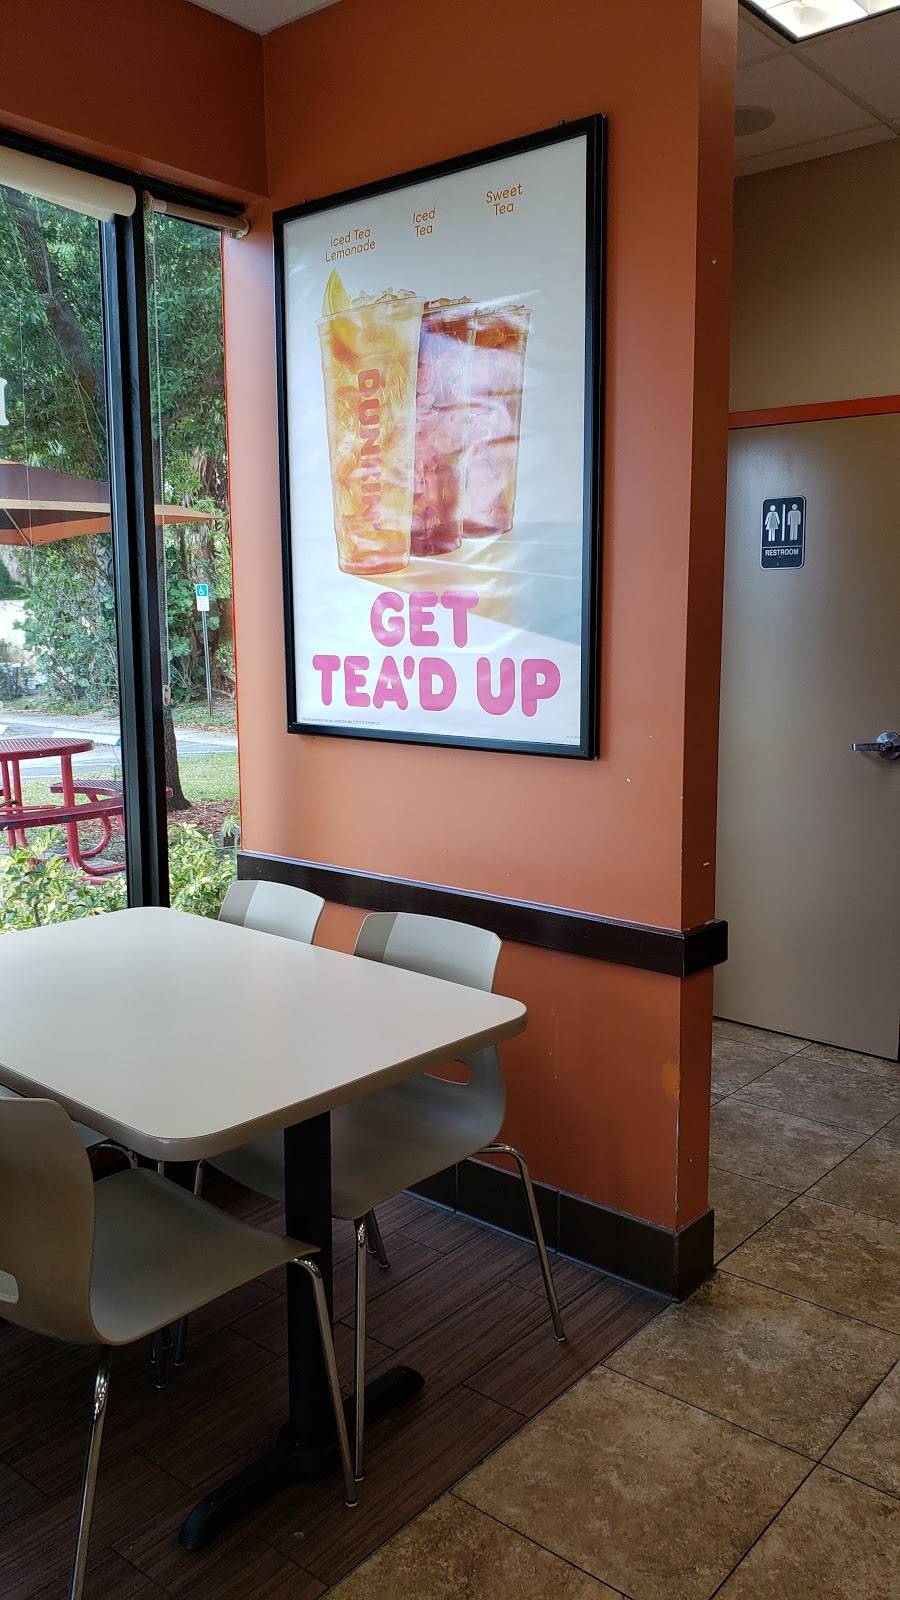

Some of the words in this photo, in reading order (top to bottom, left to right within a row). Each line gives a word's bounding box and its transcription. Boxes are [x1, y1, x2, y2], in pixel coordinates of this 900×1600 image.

[486, 183, 523, 204] Sweet
[412, 206, 436, 225] Iced
[493, 202, 515, 216] Tea
[330, 231, 351, 247] Iced
[354, 227, 371, 241] Tea
[415, 224, 433, 237] Tea
[325, 240, 376, 262] Lemonade
[765, 548, 799, 556] RESTROOM
[370, 591, 479, 648] GET
[312, 654, 457, 712] TEA'D
[476, 656, 561, 717] UP
